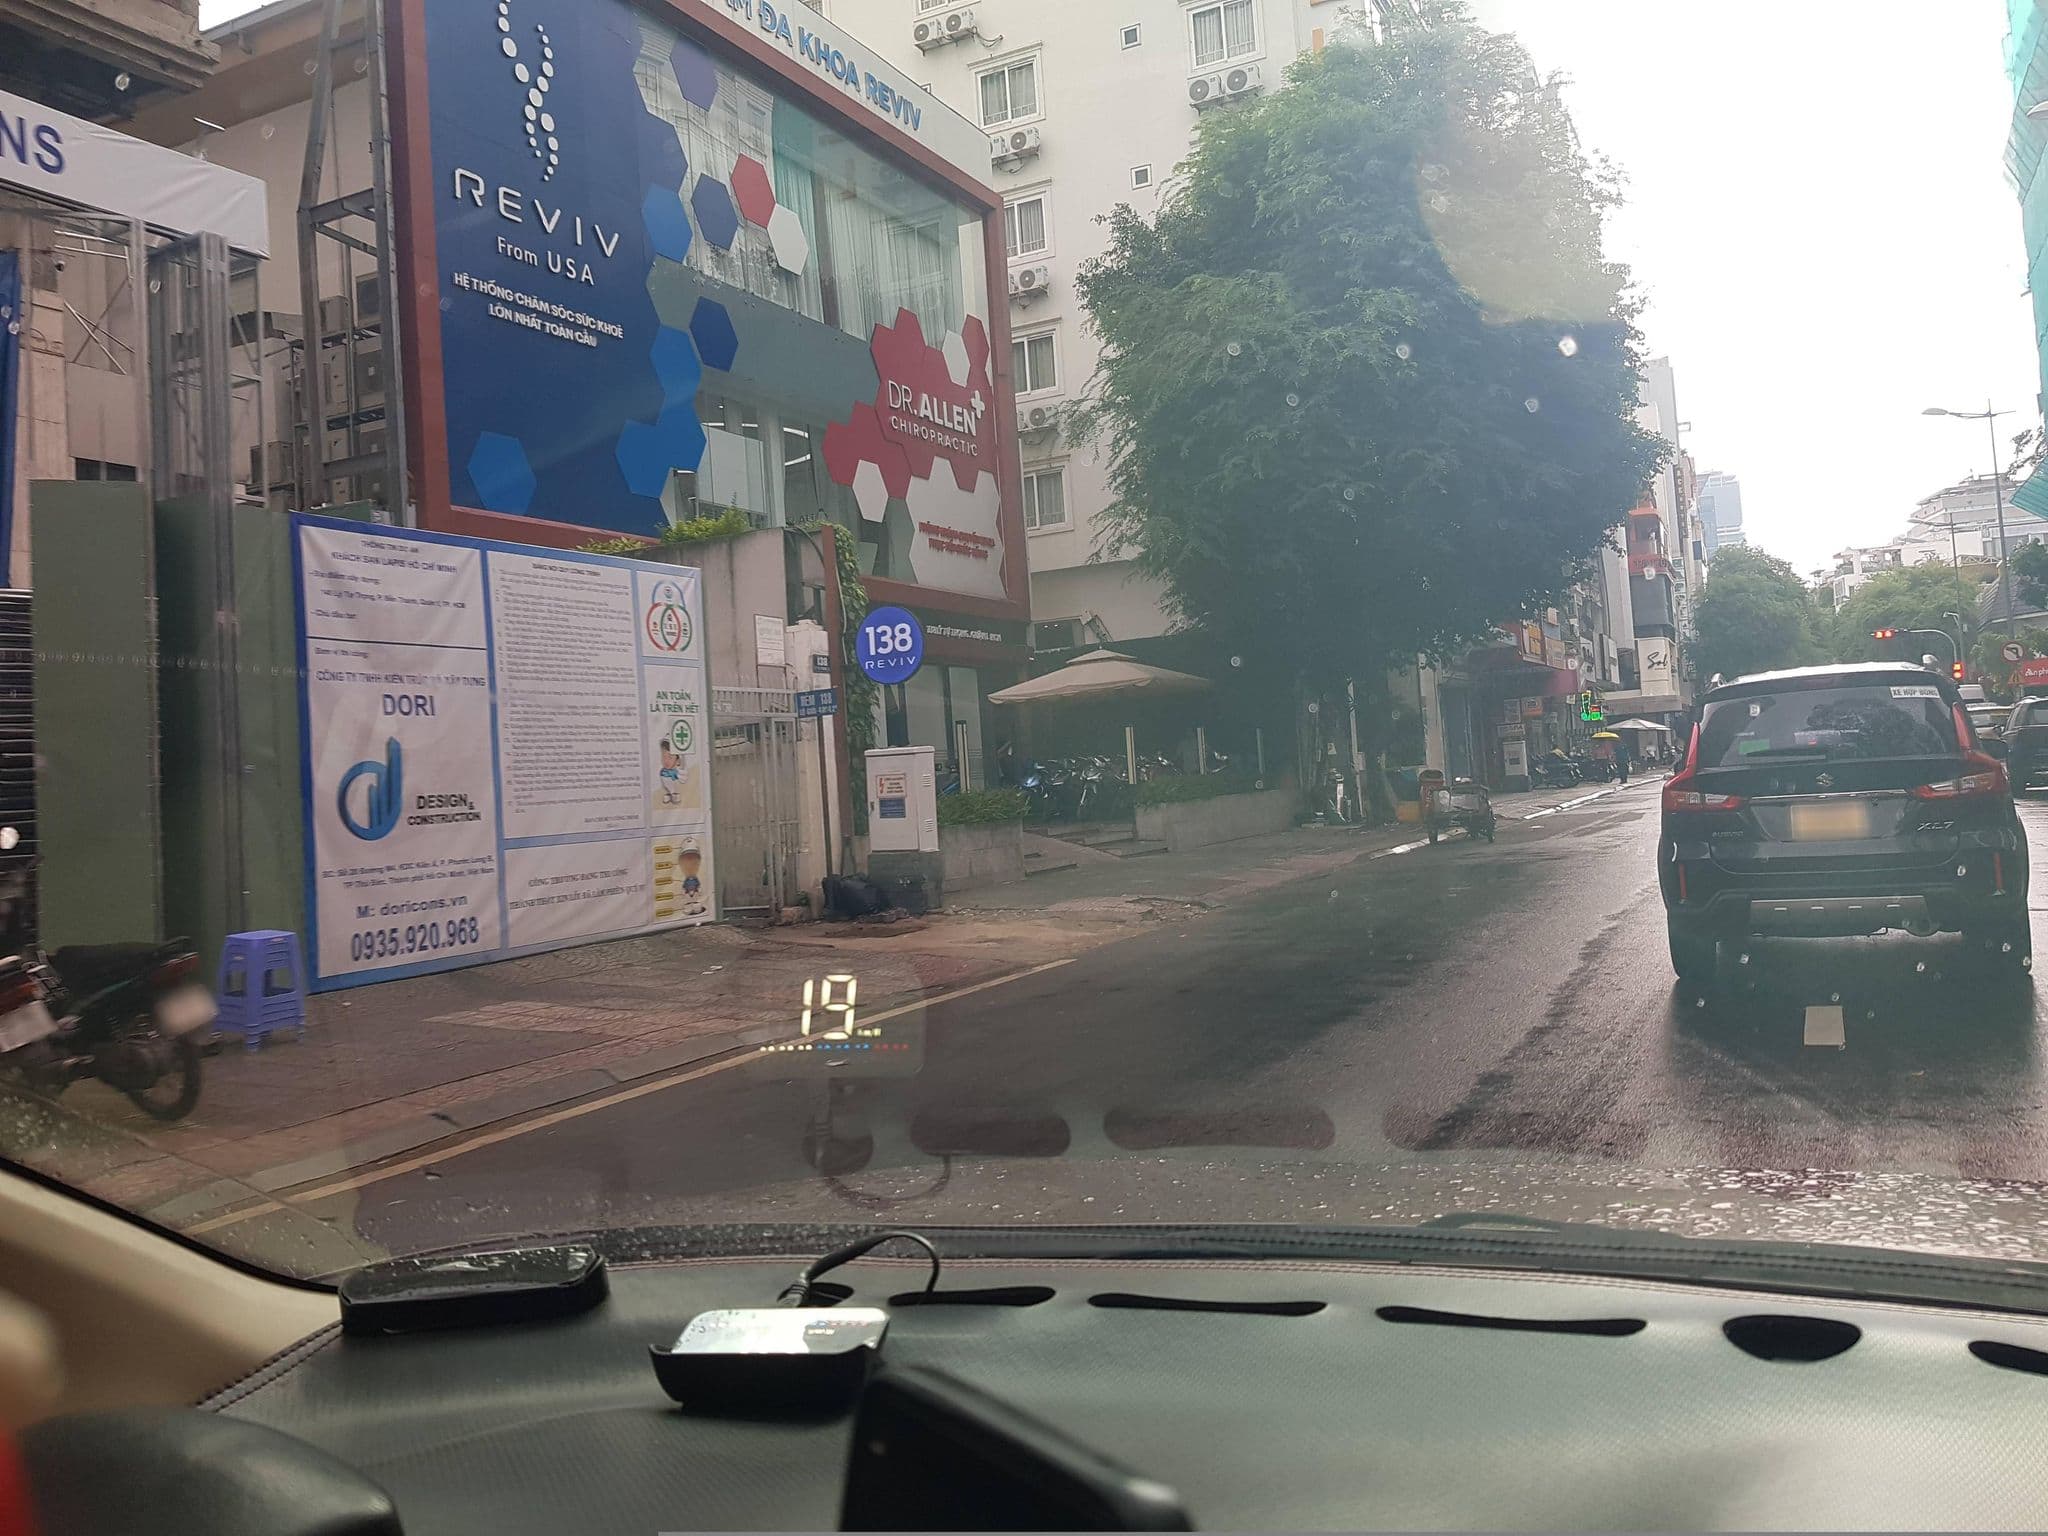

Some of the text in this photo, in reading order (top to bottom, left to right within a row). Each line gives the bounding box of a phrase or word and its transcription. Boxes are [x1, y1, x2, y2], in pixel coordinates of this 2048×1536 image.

[759, 0, 793, 47] ĐA
[798, 26, 861, 93] KHOA
[864, 72, 922, 131] REVIV
[454, 167, 620, 258] REVIV
[497, 235, 595, 286] From USA
[454, 272, 471, 291] HỆ
[471, 277, 514, 302] THỐNG
[551, 303, 575, 322] SÓC
[515, 312, 544, 331] NHẤT
[544, 321, 575, 341] TOÀN
[891, 415, 979, 457] CHIROPRACTIC
[864, 622, 914, 656] 138
[864, 656, 917, 670] REVIV
[382, 693, 436, 717] DORI
[656, 690, 668, 701] AN
[407, 811, 482, 826] CONSTRUCTION
[416, 793, 469, 810] DESIGN
[356, 895, 468, 919] M: doricons.vn
[351, 916, 480, 962] 0935.920.968
[801, 973, 858, 1041] 19
